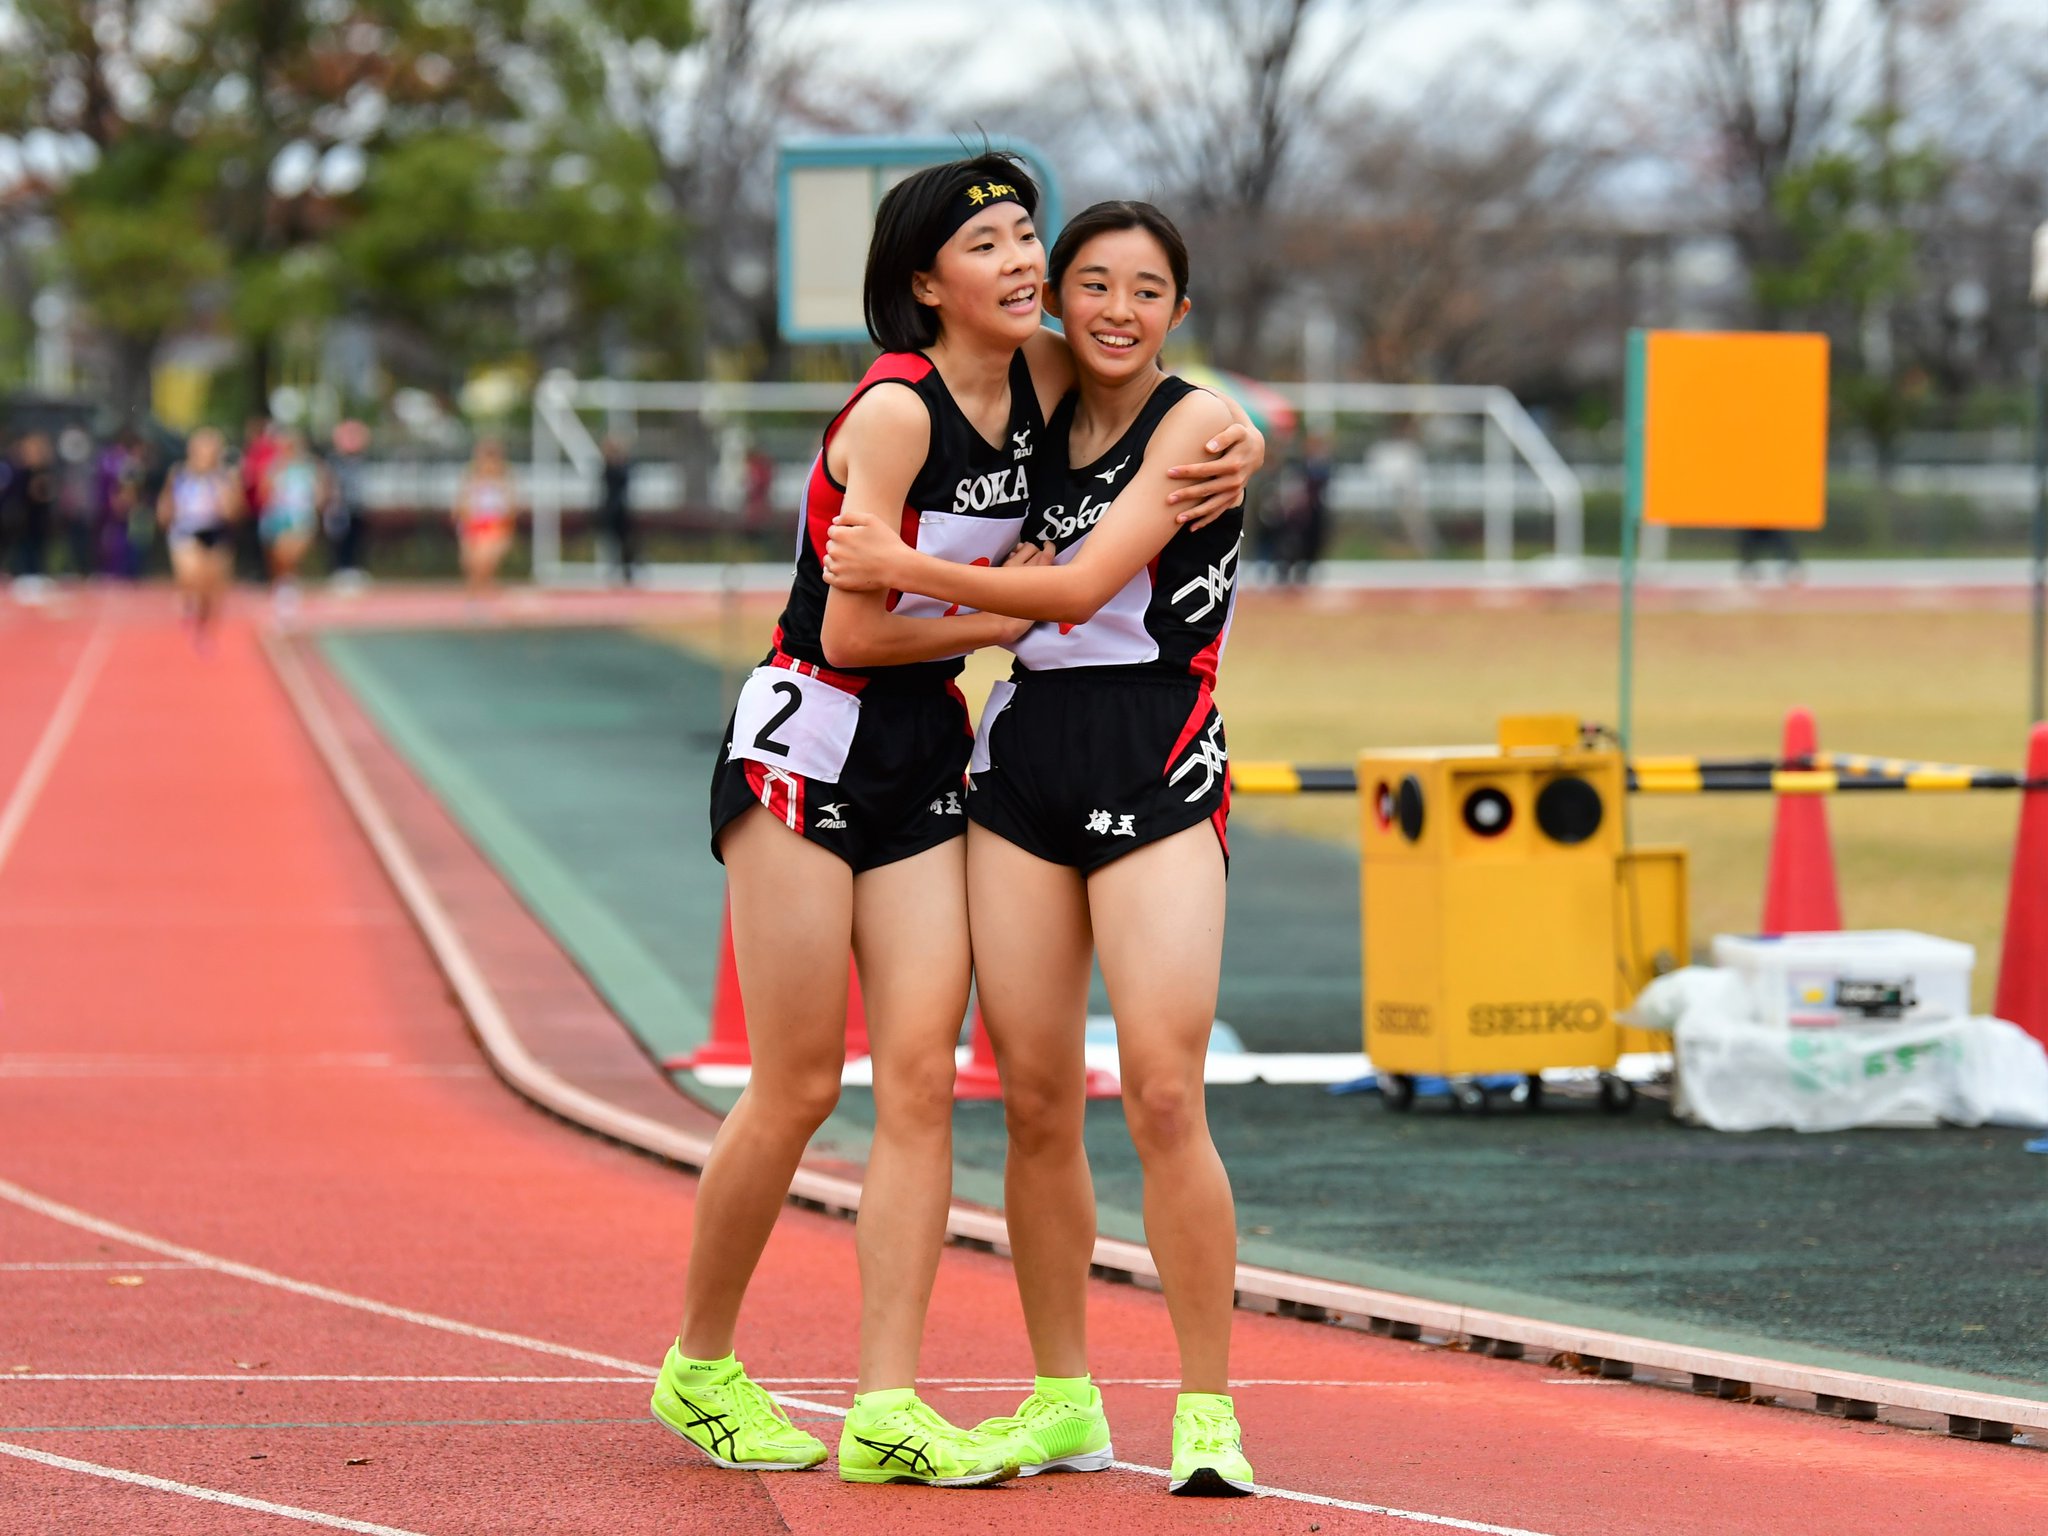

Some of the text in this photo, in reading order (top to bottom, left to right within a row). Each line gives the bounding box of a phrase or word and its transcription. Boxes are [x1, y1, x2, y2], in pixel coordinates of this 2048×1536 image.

[953, 465, 1029, 513] SOKA
[1036, 495, 1111, 541] Soka
[753, 681, 802, 757] 2
[1085, 809, 1136, 837] 埼玉
[1467, 998, 1606, 1038] SEIKO
